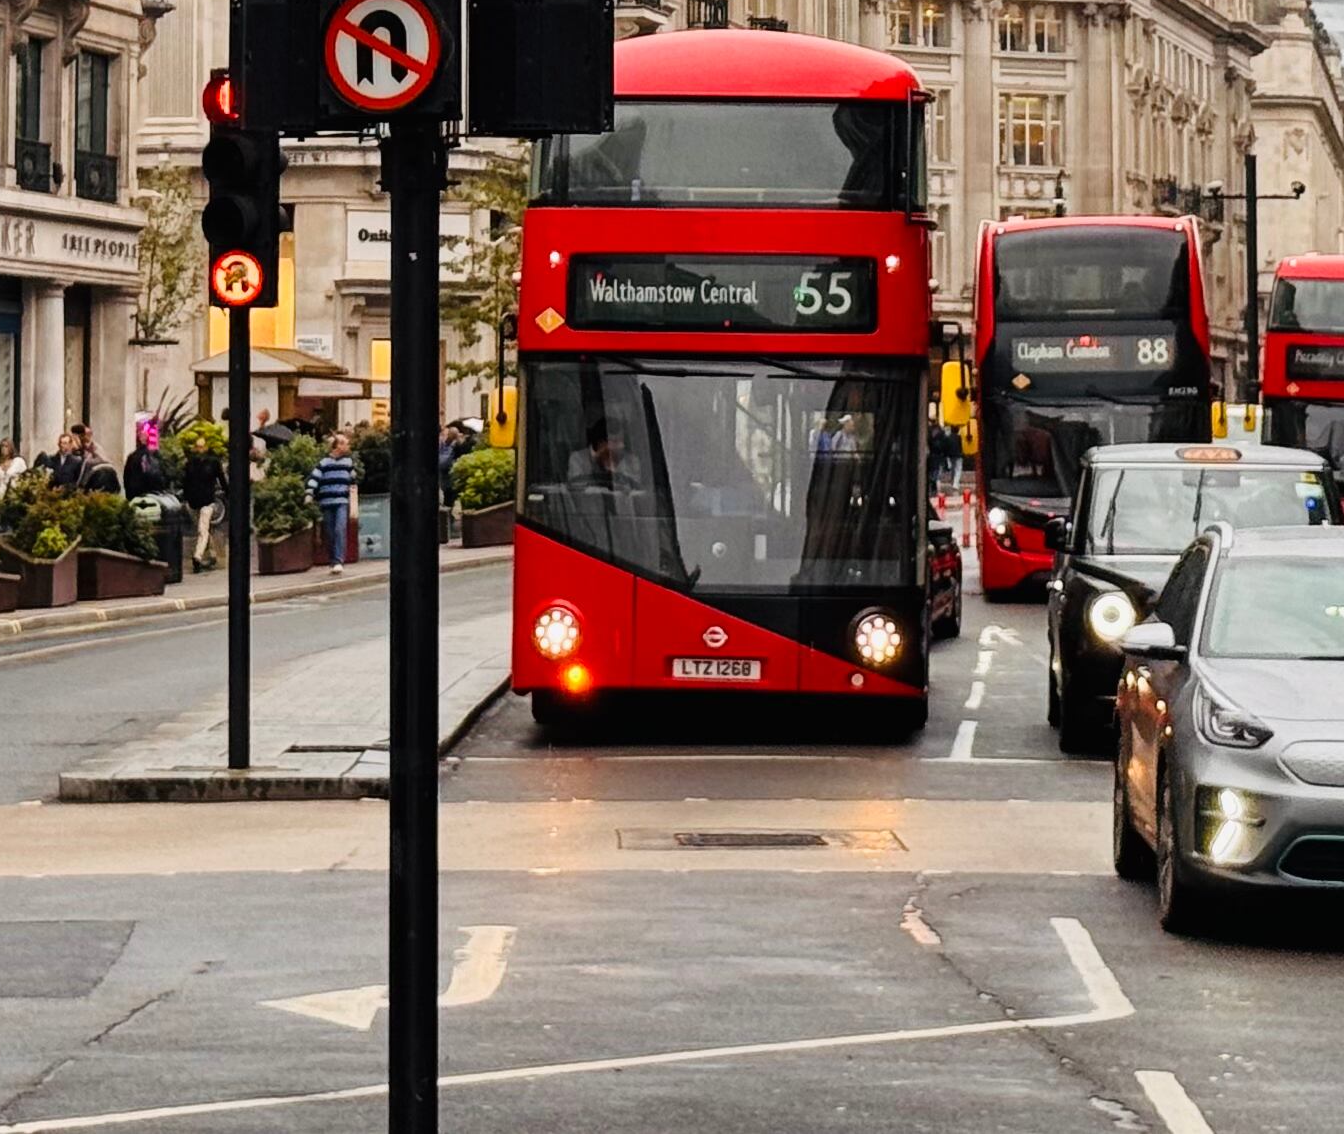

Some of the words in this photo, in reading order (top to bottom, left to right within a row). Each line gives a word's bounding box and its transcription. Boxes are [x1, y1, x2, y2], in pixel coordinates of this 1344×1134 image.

[590, 277, 696, 304] Walthamstow
[700, 280, 758, 304] Central
[796, 272, 852, 315] 55
[1017, 342, 1064, 363] Clapham
[1138, 338, 1168, 364] 88
